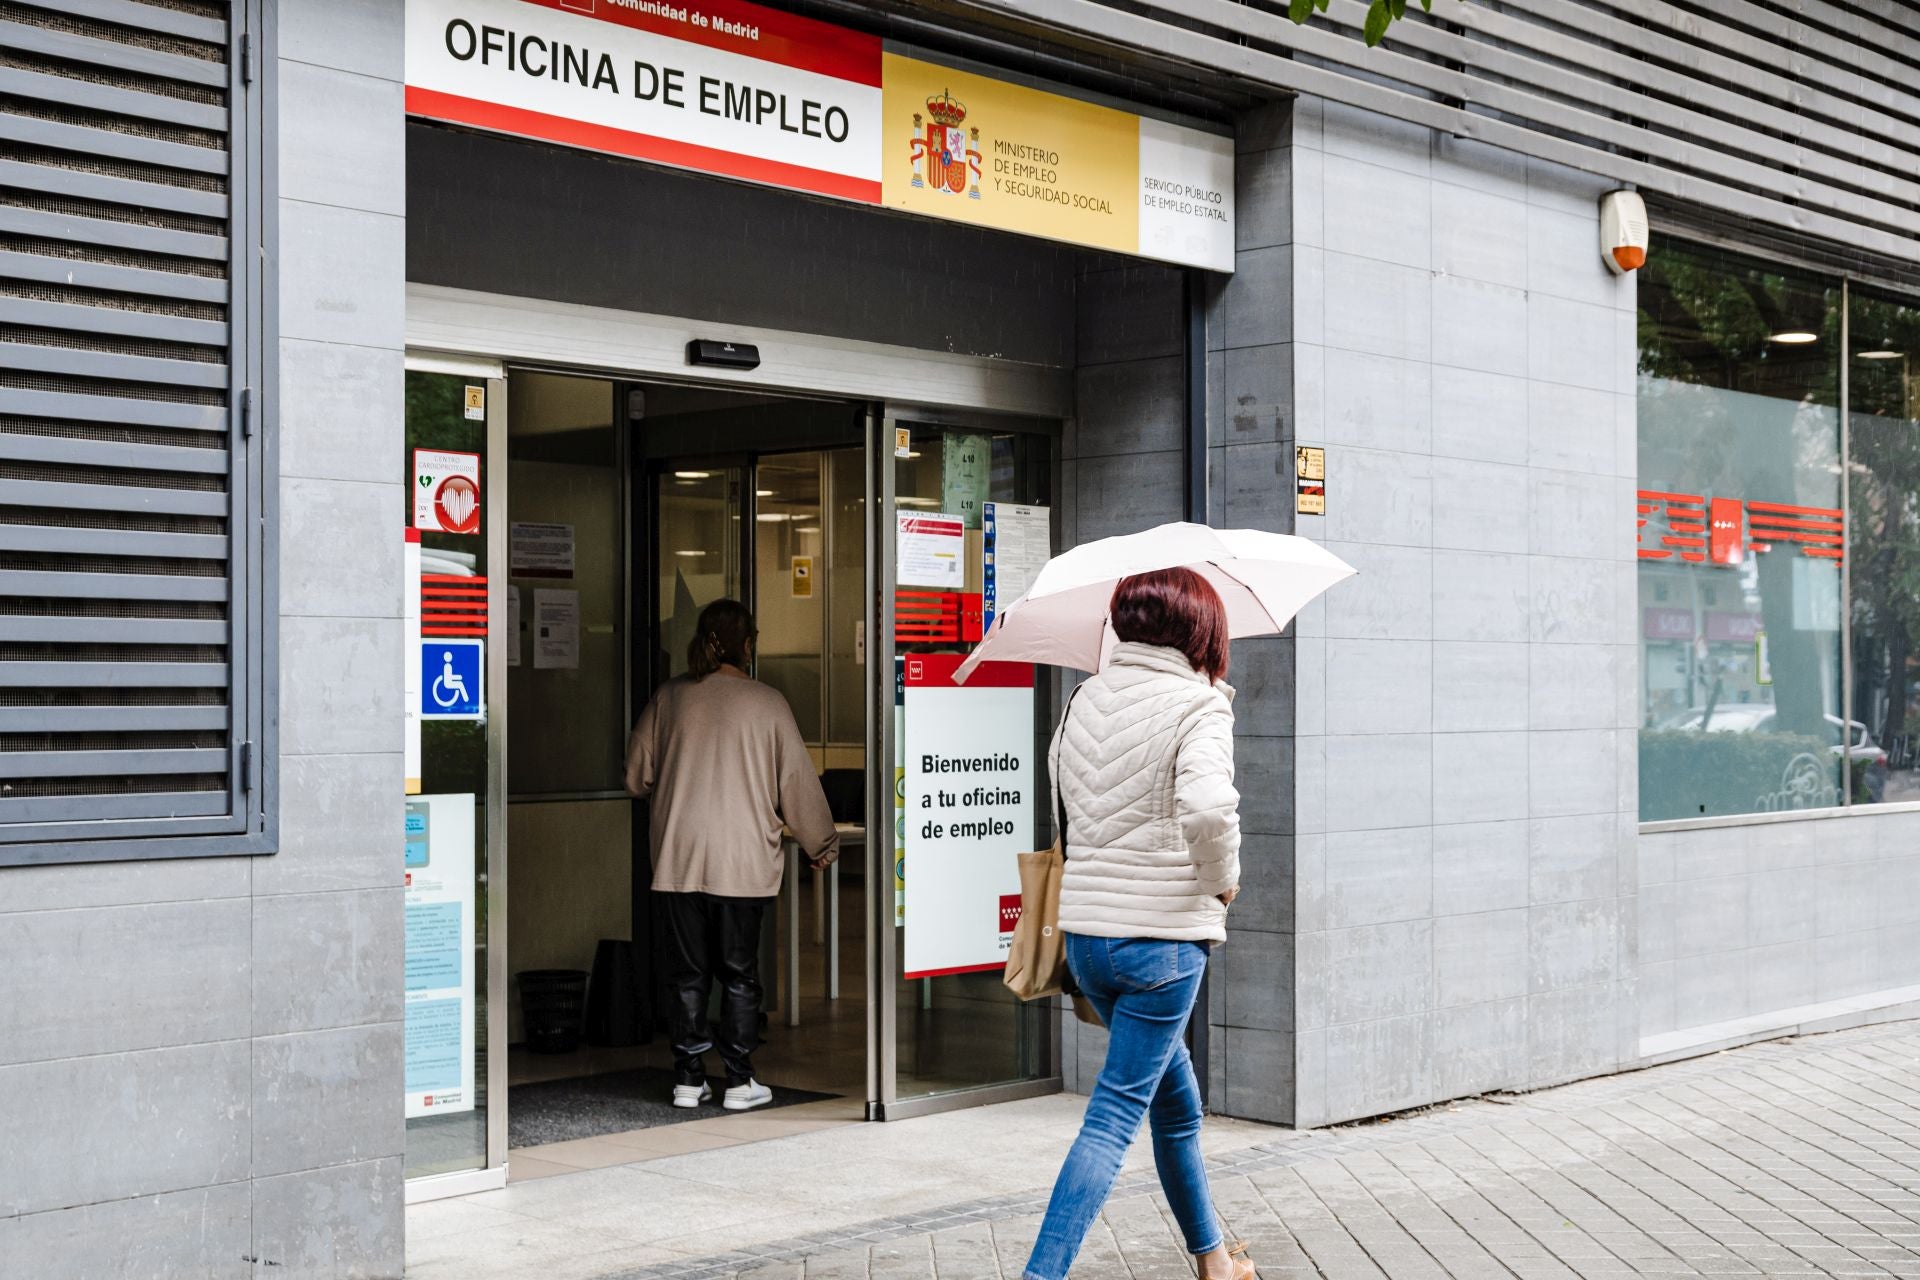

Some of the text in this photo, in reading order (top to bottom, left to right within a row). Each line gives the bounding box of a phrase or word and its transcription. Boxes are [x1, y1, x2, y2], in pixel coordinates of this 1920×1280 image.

[691, 11, 708, 27] de
[712, 16, 759, 41] Madrid
[445, 18, 850, 143] OFICINA DE EMPLEO
[994, 139, 1059, 166] MINISTERIO
[994, 158, 1057, 184] DE EMPLEO
[994, 177, 1112, 215] Y SEGURIDAD SOCIAL
[1144, 177, 1222, 204] SERVICIO PÚBLICO
[1144, 194, 1228, 222] DE EMPLEO ESTATAL
[922, 753, 1019, 773] Bienvenido
[921, 787, 1021, 808] a tu oficina
[921, 817, 1014, 840] de empleo
